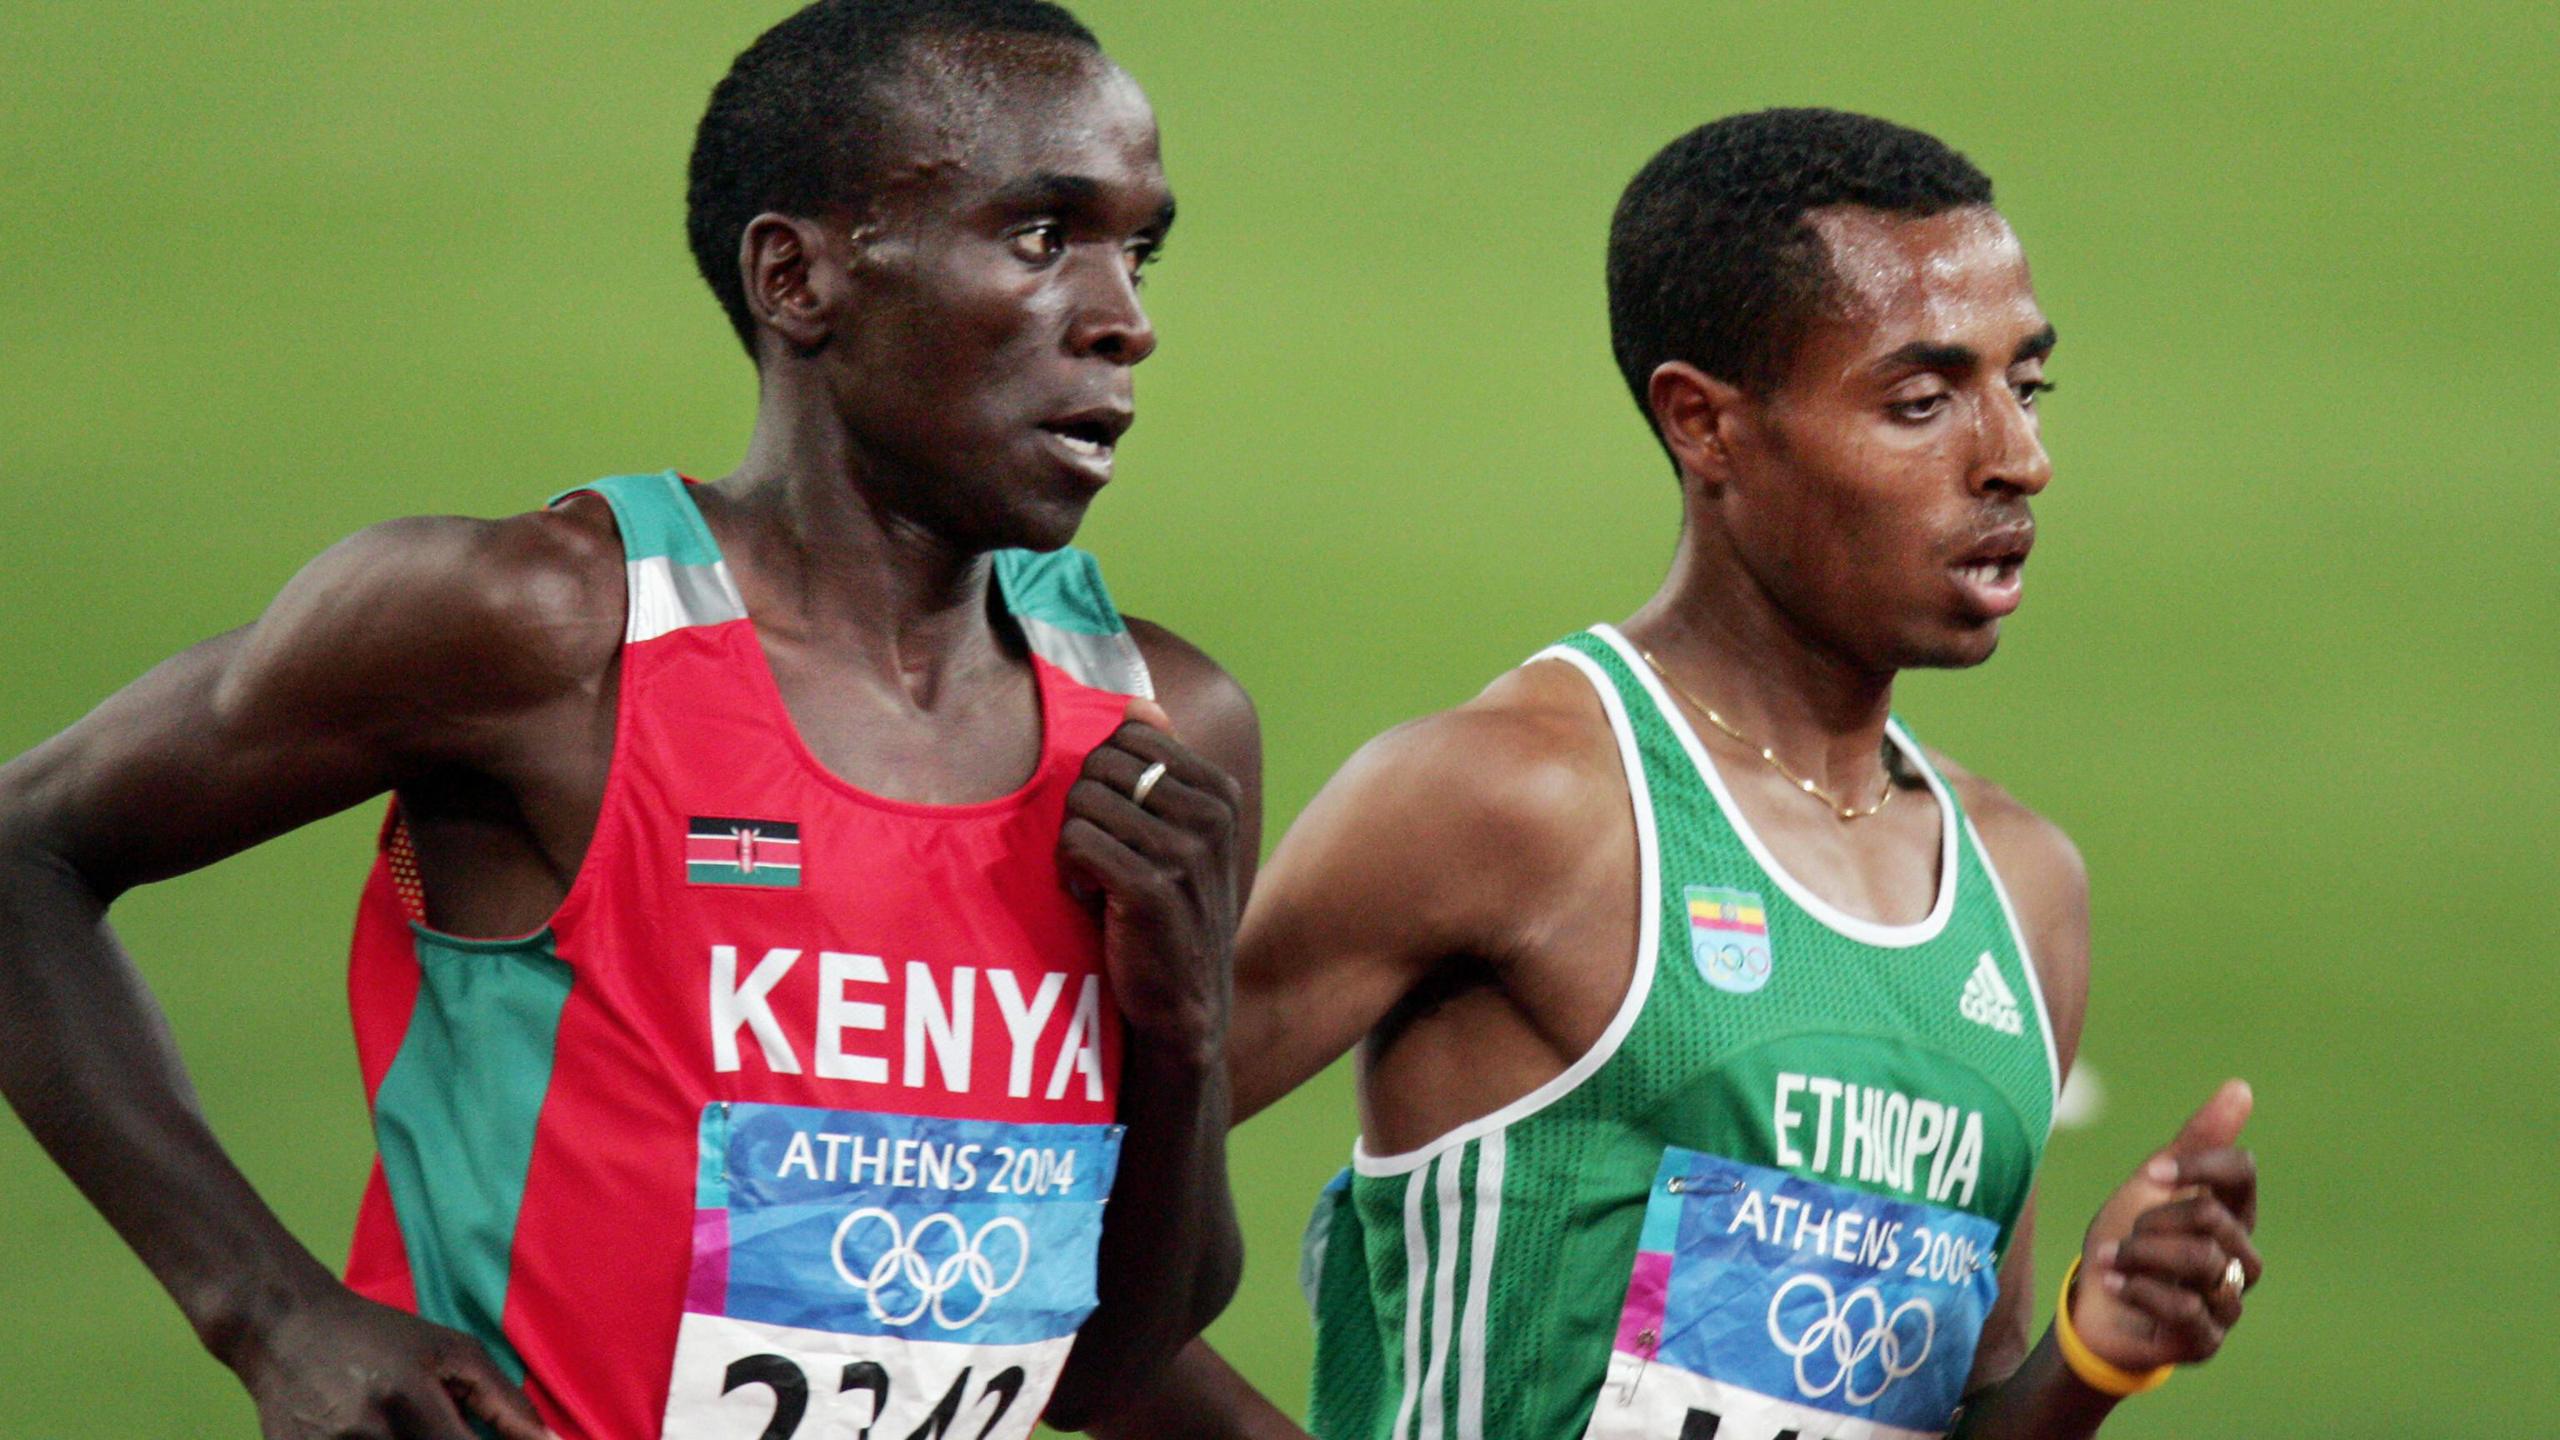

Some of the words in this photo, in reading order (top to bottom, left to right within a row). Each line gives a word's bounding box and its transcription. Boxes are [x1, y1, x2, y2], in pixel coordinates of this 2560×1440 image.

[709, 944, 1105, 1102] KENYA
[777, 1131, 982, 1191] ATHENS
[986, 1147, 1076, 1196] 2004
[1774, 1072, 1983, 1207] ETHIOPIA
[1726, 1190, 1903, 1271] ATHENS
